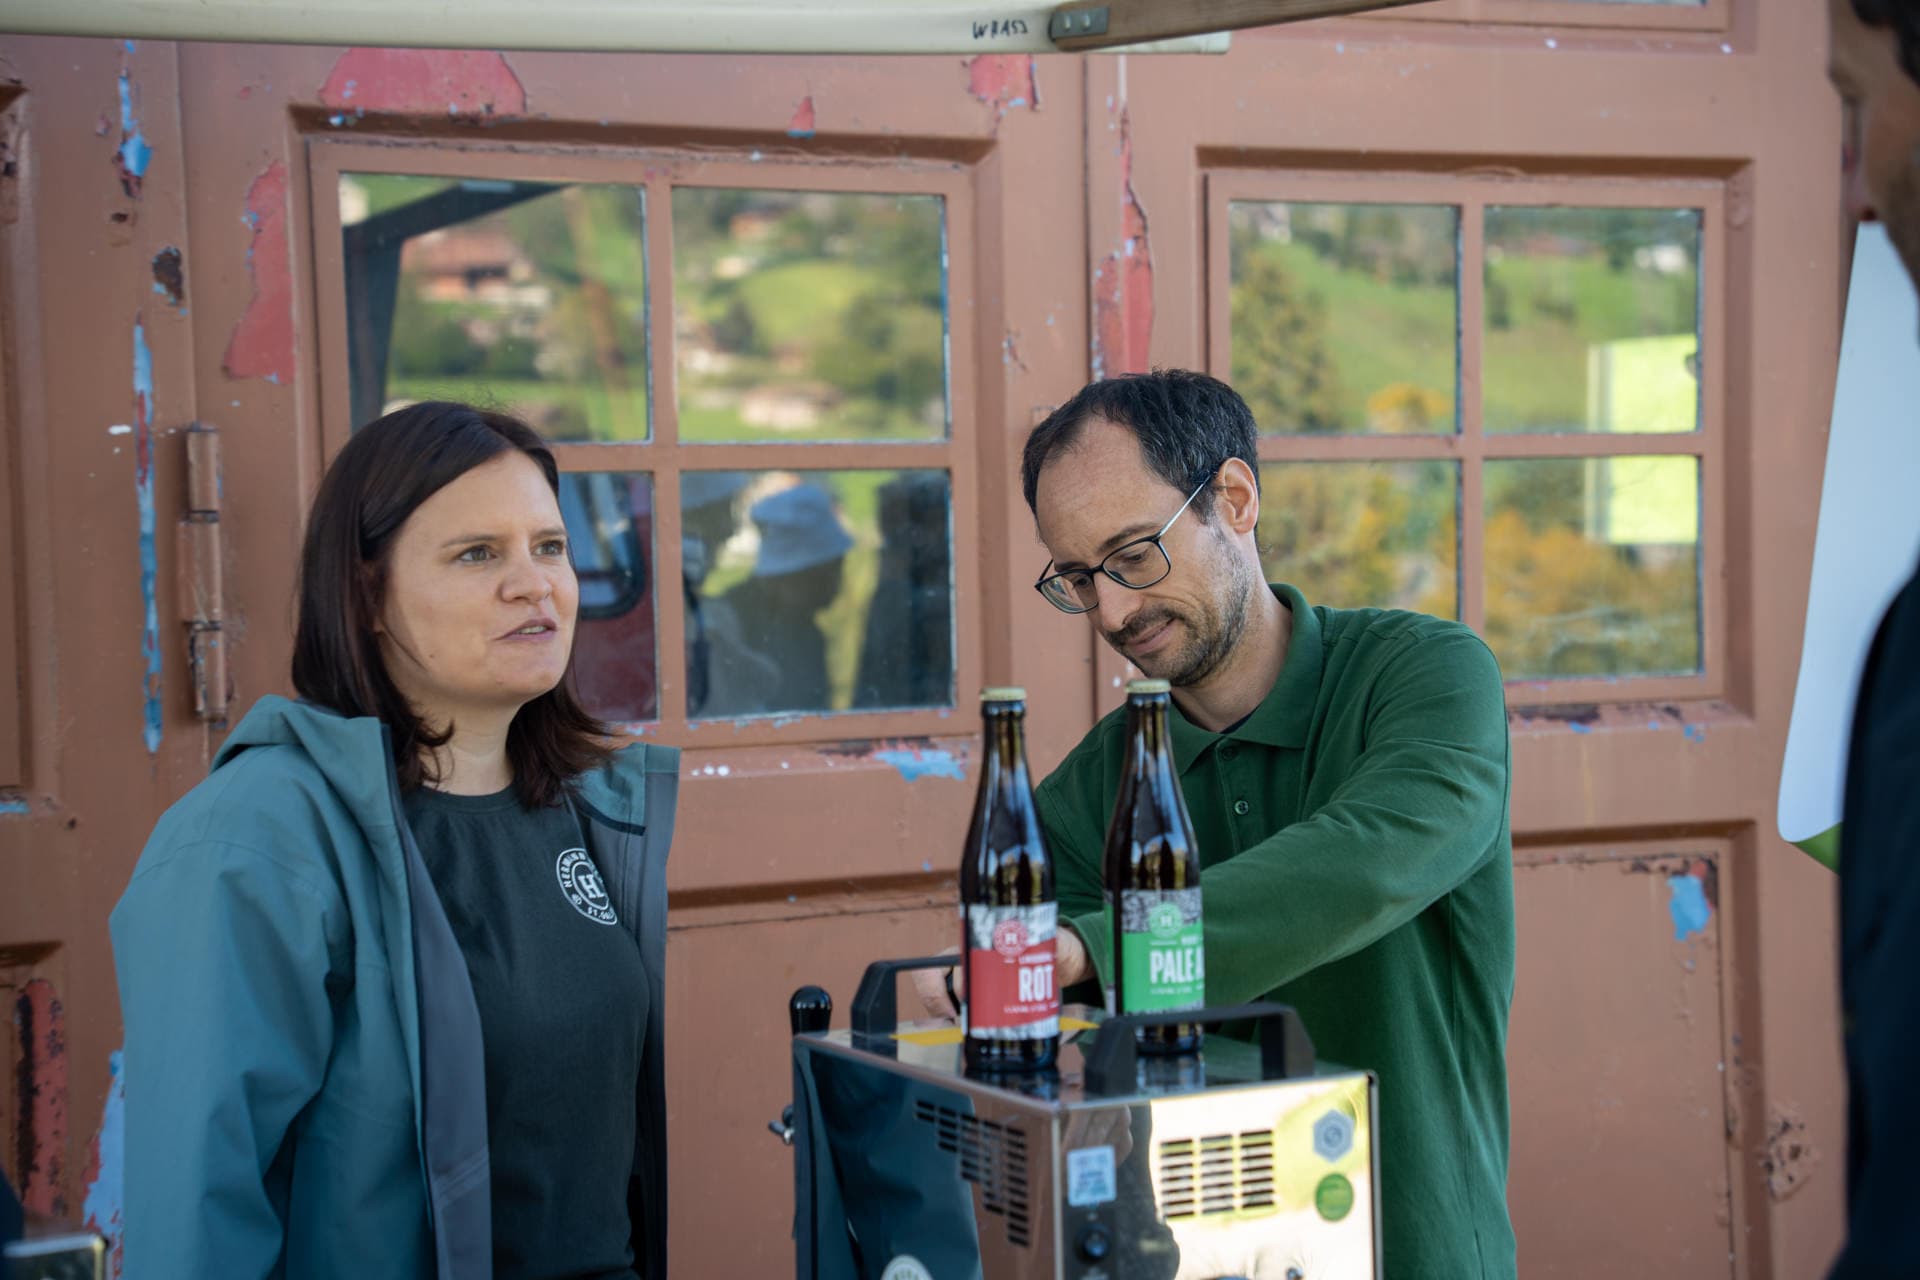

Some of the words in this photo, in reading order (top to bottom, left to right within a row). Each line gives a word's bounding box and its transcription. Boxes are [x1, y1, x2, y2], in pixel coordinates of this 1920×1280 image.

[577, 874, 605, 898] H
[1019, 964, 1054, 1002] ROT
[1149, 948, 1194, 984] PALE
